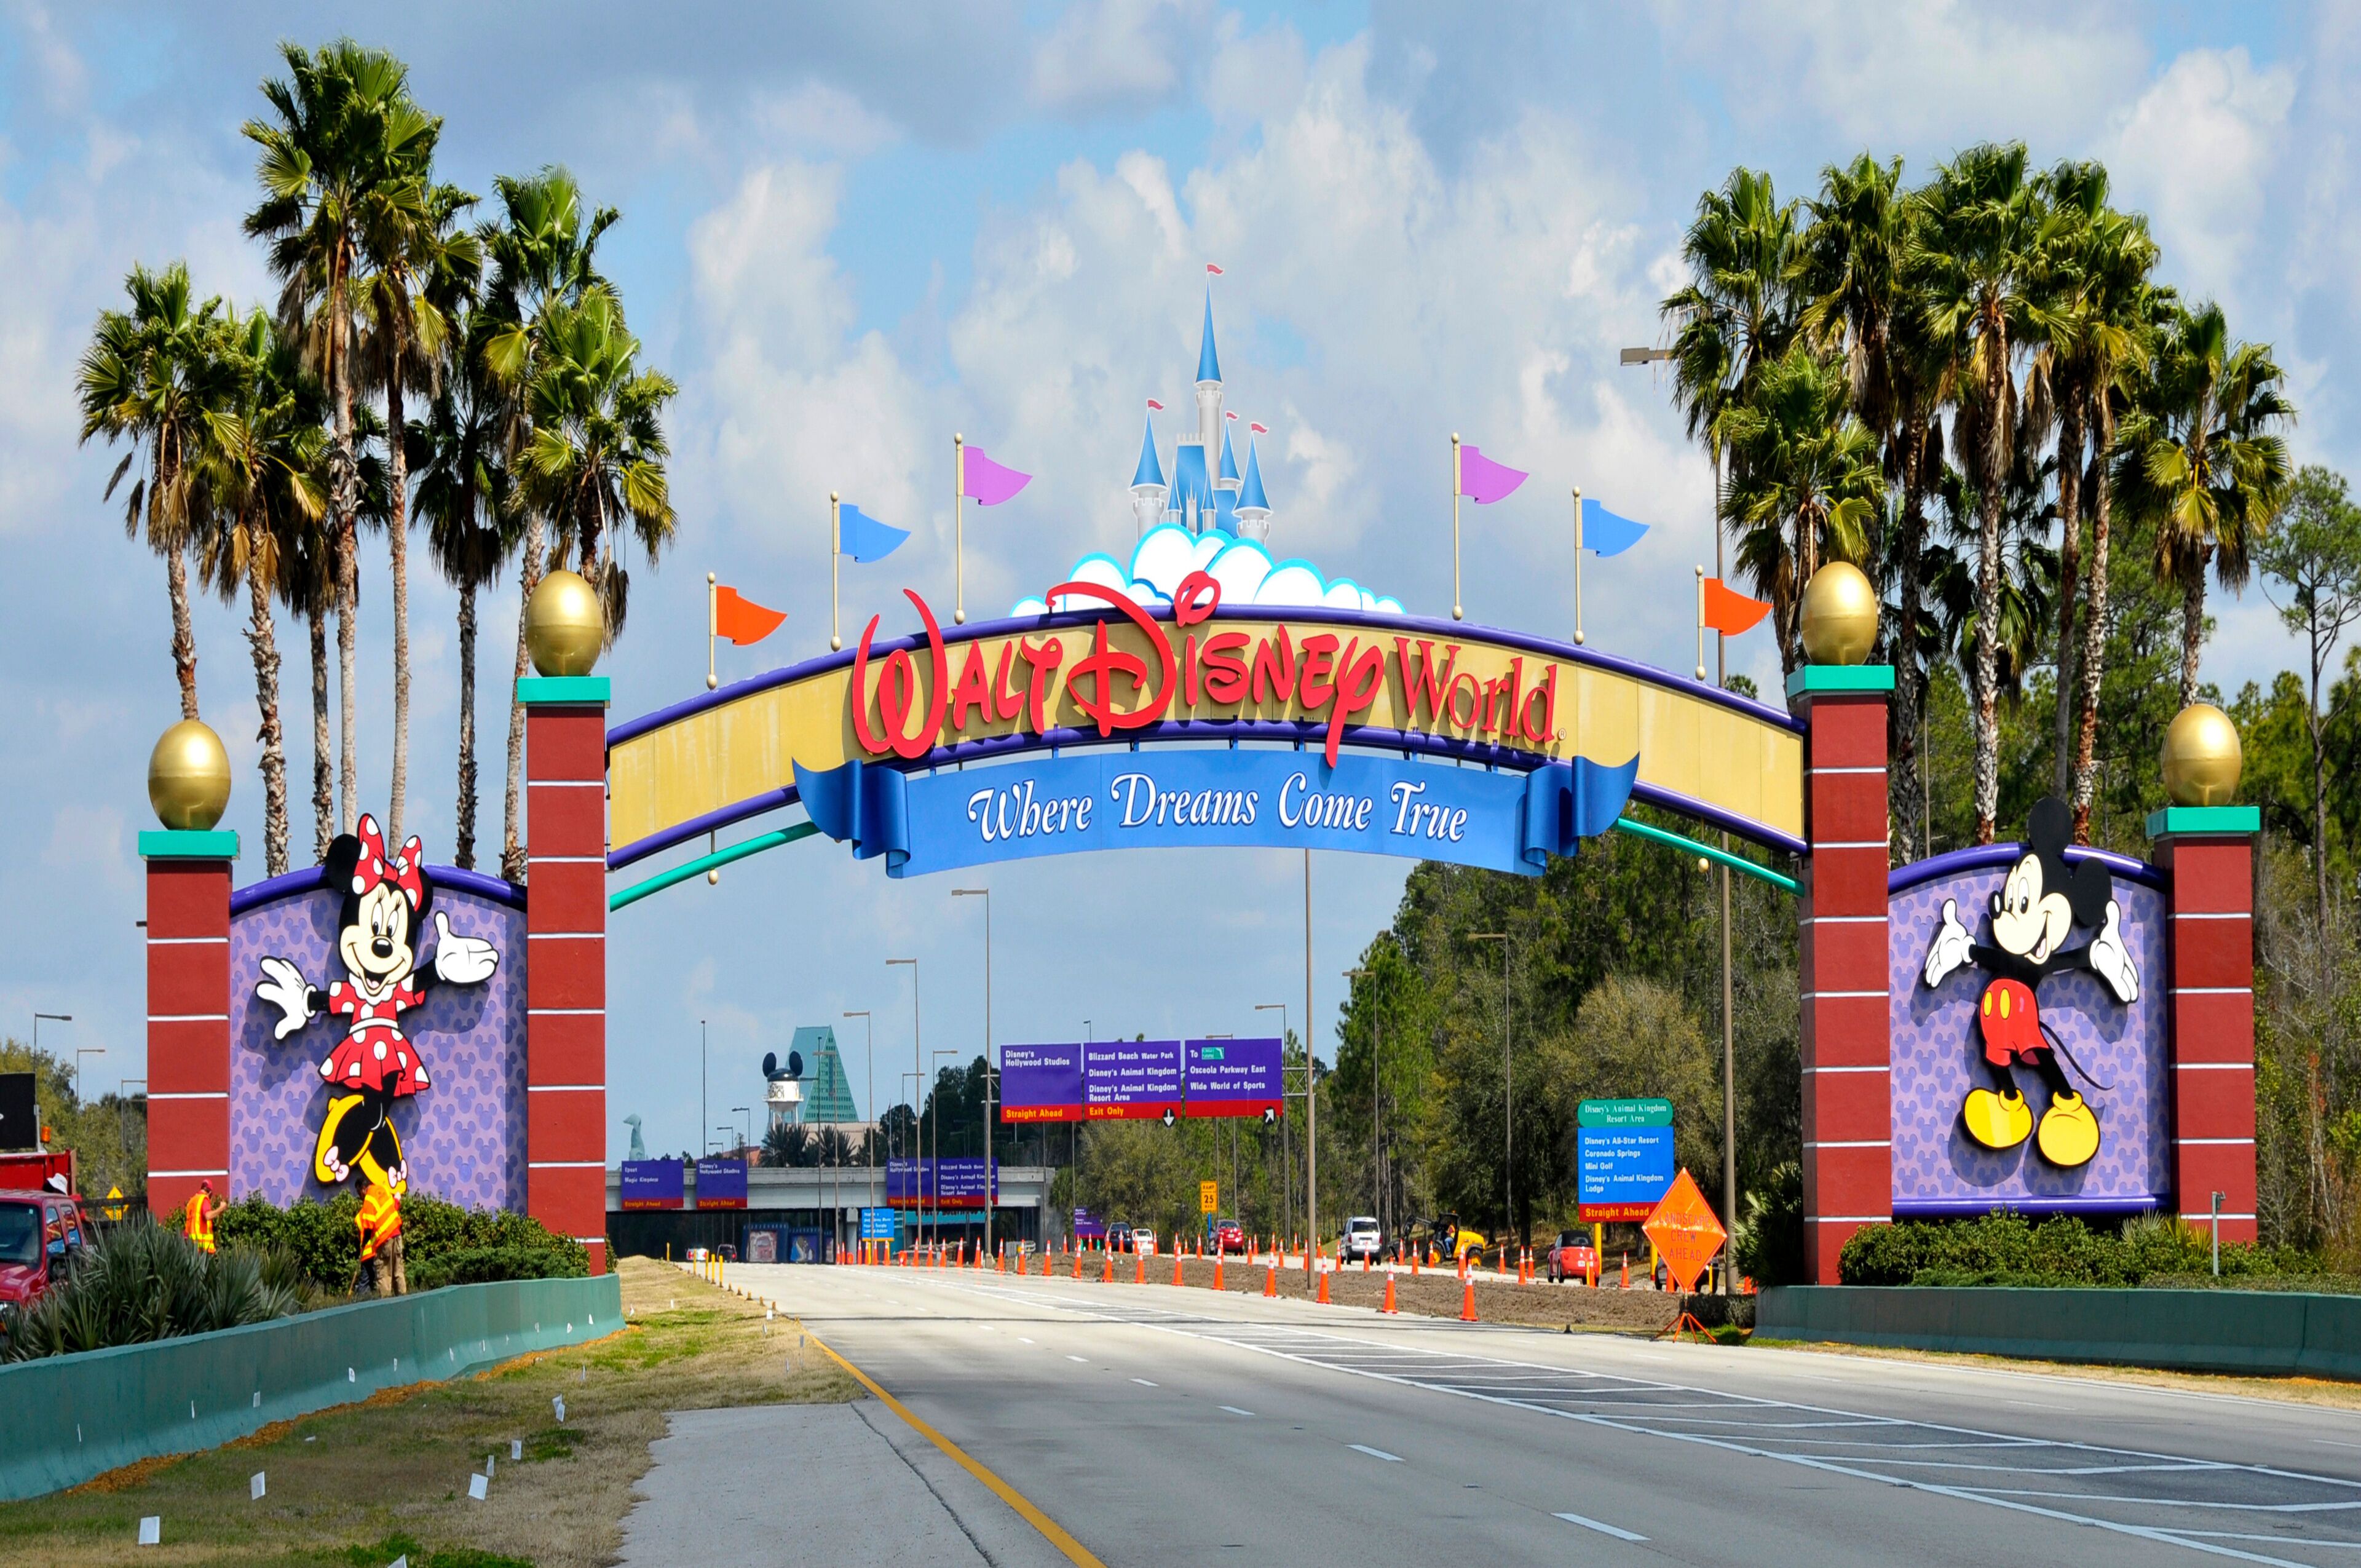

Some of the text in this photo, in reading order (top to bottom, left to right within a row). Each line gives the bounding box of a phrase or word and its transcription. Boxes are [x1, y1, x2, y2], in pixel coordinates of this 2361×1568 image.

[1394, 636, 1558, 743] World
[968, 772, 1468, 841] Where Dreams Come True
[1006, 1050, 1034, 1059] Disney's
[1088, 1052, 1115, 1061] Blizzard
[1118, 1051, 1138, 1060] Beach
[1006, 1058, 1042, 1067] Hollywood
[1088, 1069, 1117, 1077] Disney's
[1147, 1067, 1177, 1077] Kingdom
[1220, 1065, 1248, 1075] Parkway
[1089, 1083, 1177, 1093] Disney's Animal Kingdom
[1190, 1082, 1207, 1090] Wide
[1243, 1081, 1265, 1091] Sports
[1006, 1109, 1062, 1119] Straight Ahead
[1090, 1107, 1124, 1117] Exit Only
[1585, 1104, 1609, 1115] Disney's
[1639, 1104, 1666, 1113] Kingdom
[1617, 1150, 1640, 1158] Springs
[1585, 1175, 1610, 1184] Disney's
[1637, 1174, 1664, 1183] Kingdom
[1204, 1195, 1214, 1203] 25
[1586, 1207, 1649, 1219] Straight Ahead
[1659, 1212, 1712, 1229] LANDSCAPE
[1671, 1230, 1696, 1243] CREW
[1669, 1248, 1702, 1261] AHEAD
